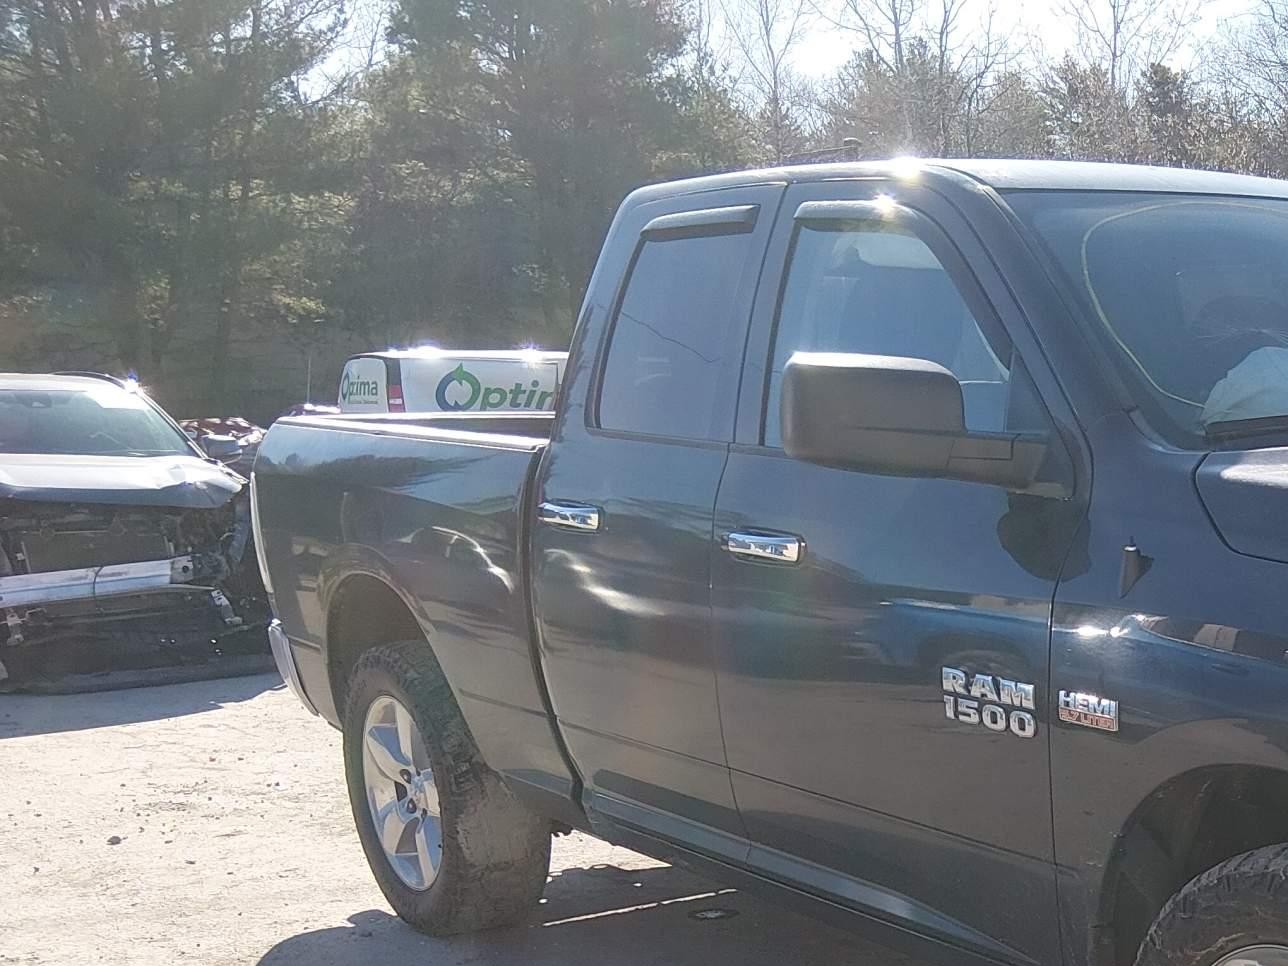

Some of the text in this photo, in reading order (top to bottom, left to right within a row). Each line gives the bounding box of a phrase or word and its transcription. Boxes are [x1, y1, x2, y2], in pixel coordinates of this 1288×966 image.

[341, 370, 378, 404] Optima
[942, 666, 1036, 710] RAM
[1058, 690, 1117, 718] HEMI
[943, 695, 1037, 739] 1500
